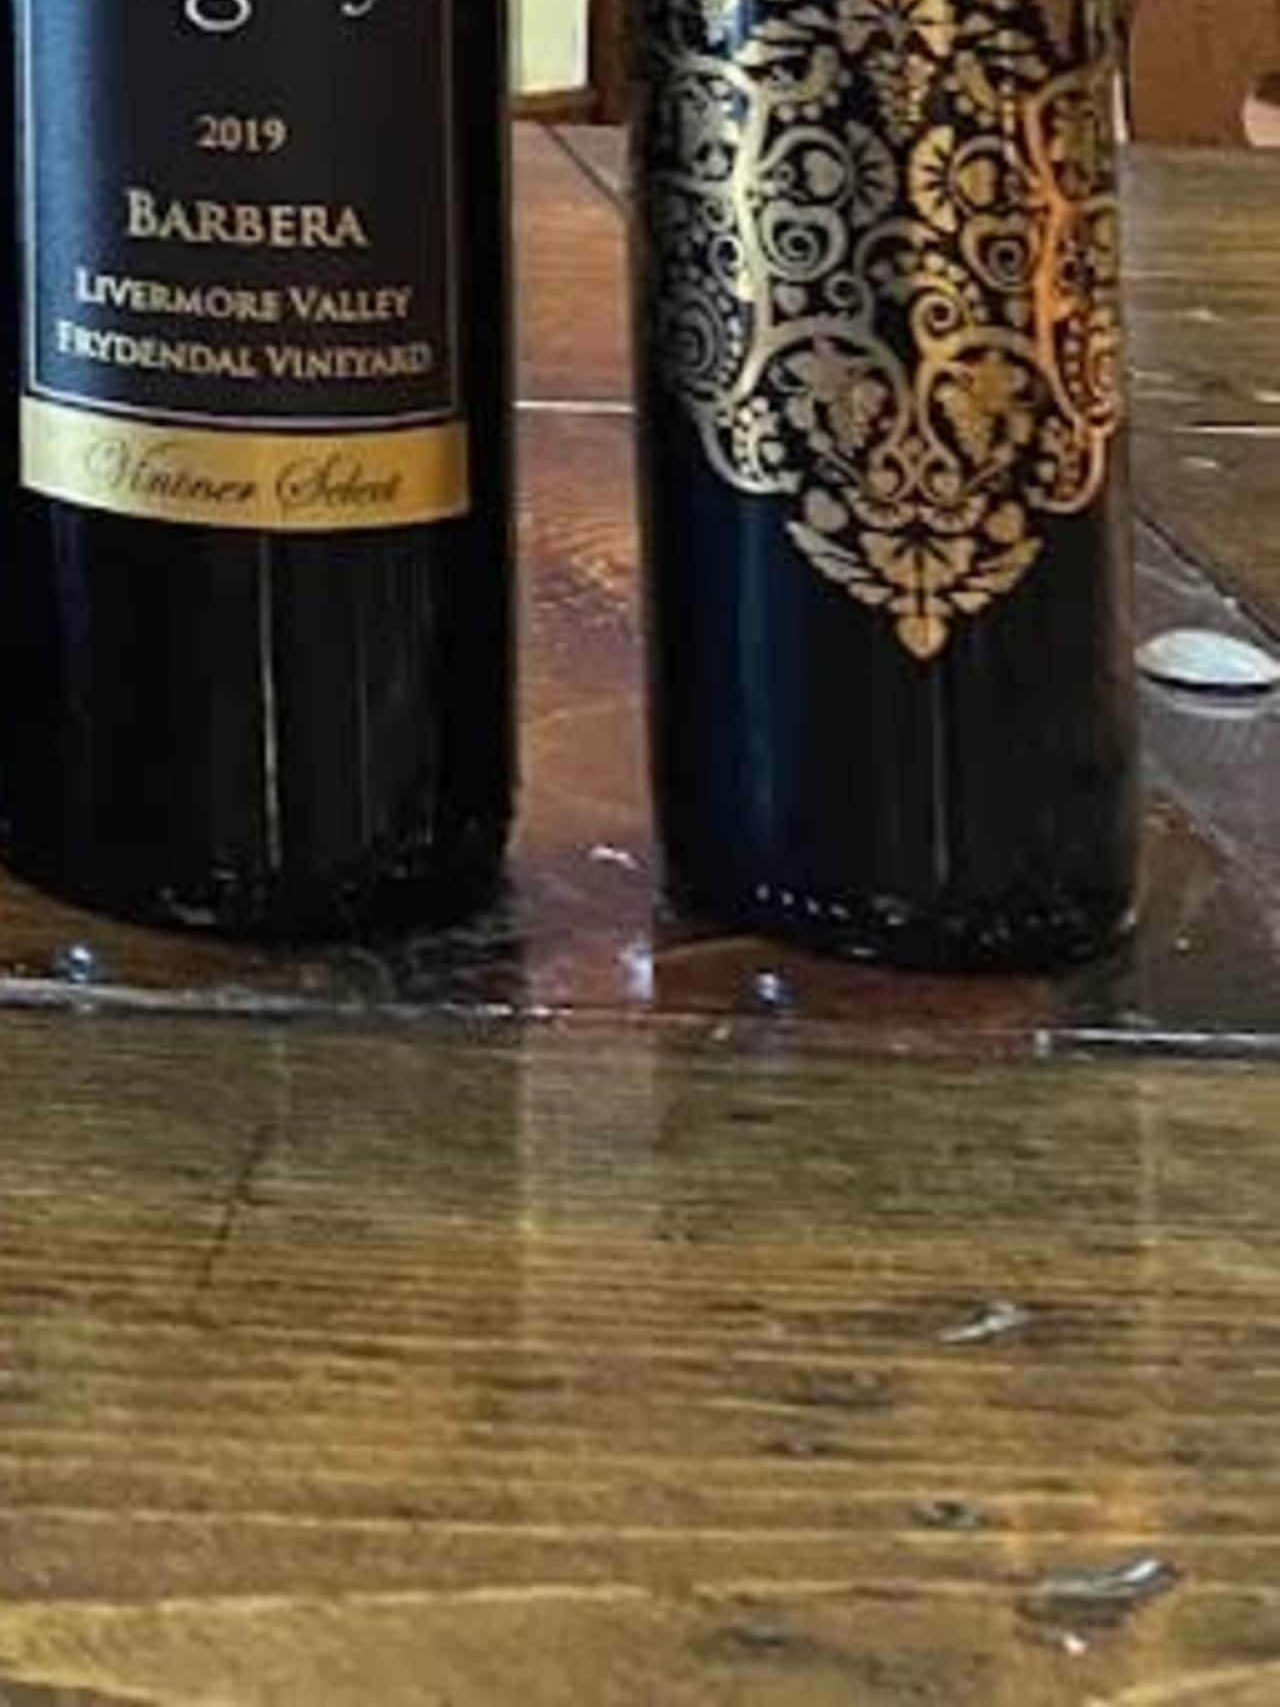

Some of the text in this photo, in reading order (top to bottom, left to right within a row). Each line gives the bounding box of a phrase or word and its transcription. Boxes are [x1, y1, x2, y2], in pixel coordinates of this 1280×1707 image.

[196, 115, 288, 152] 2019
[127, 188, 370, 248] BARBERA
[74, 266, 414, 323] LIVERMORE VALLEY
